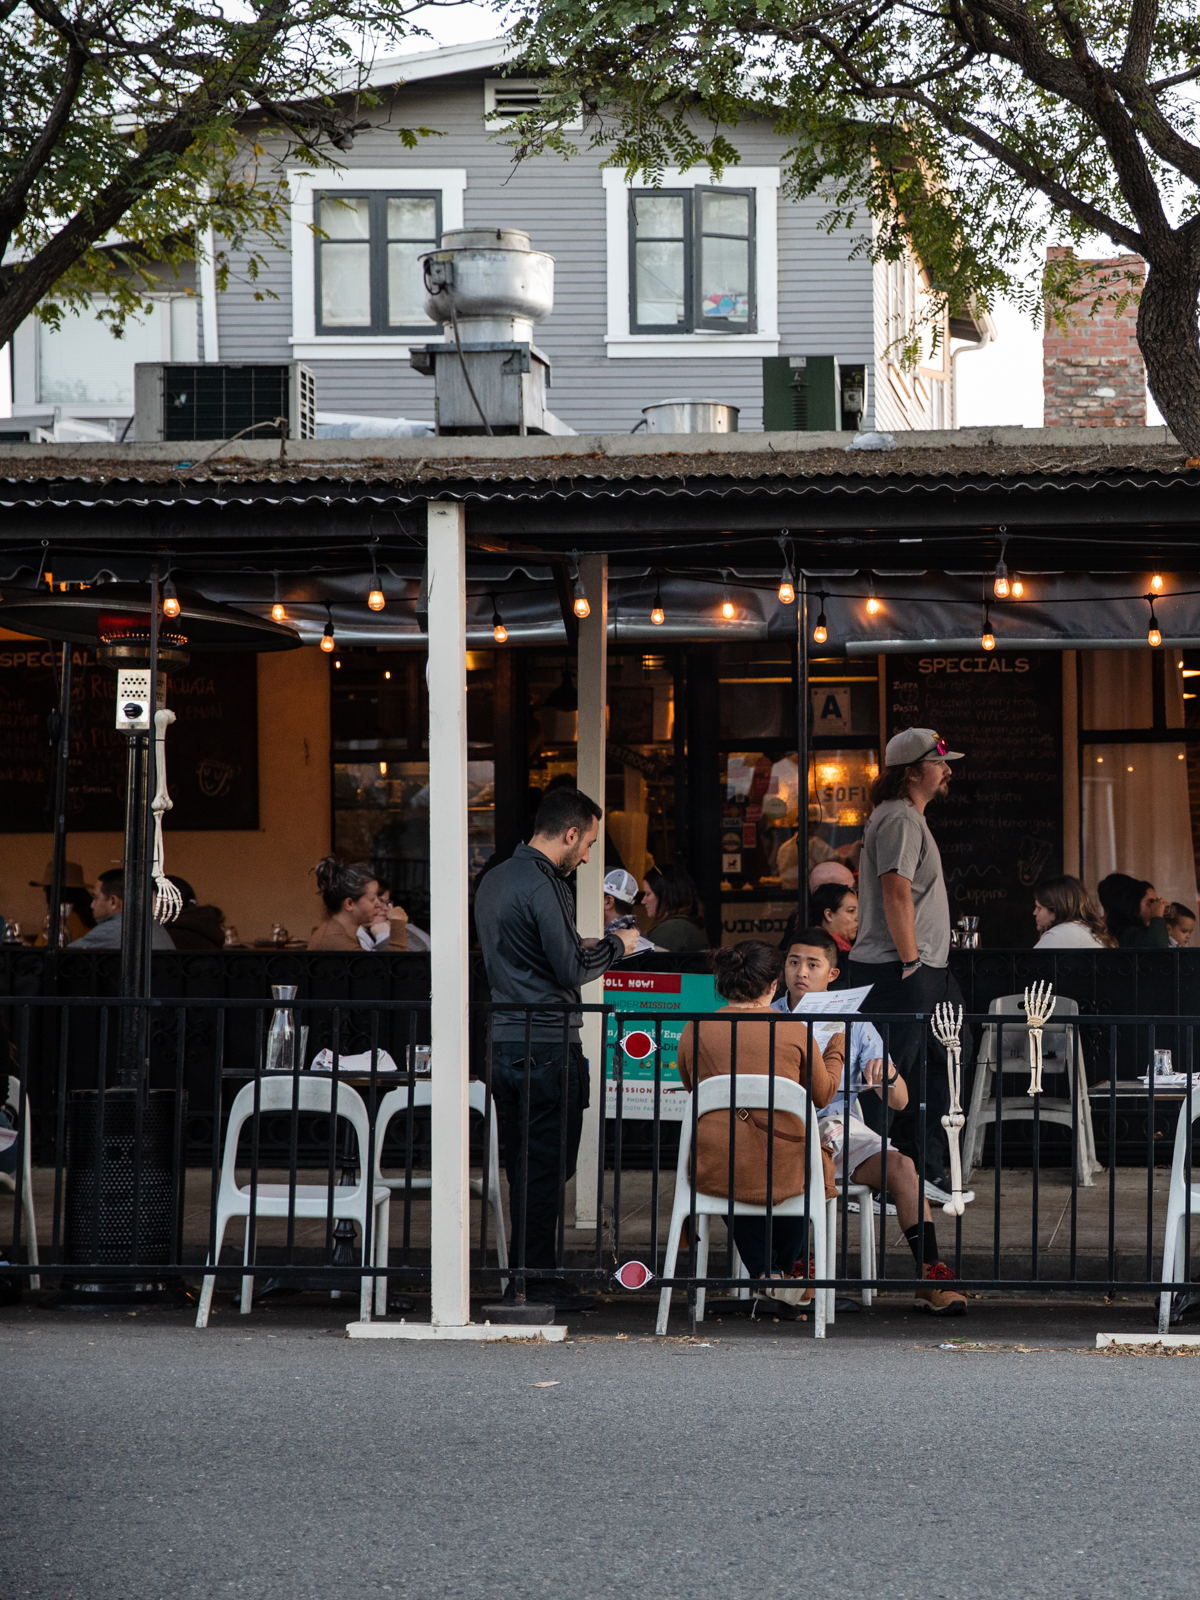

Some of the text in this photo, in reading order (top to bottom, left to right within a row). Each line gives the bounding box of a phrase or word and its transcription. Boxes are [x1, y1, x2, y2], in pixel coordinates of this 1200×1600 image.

[0, 651, 101, 667] SPECAL
[918, 657, 1030, 673] SPECIALS
[820, 695, 843, 719] A
[893, 703, 919, 713] PASTA
[721, 918, 789, 933] UINDI
[603, 979, 654, 989] OLL NOW!
